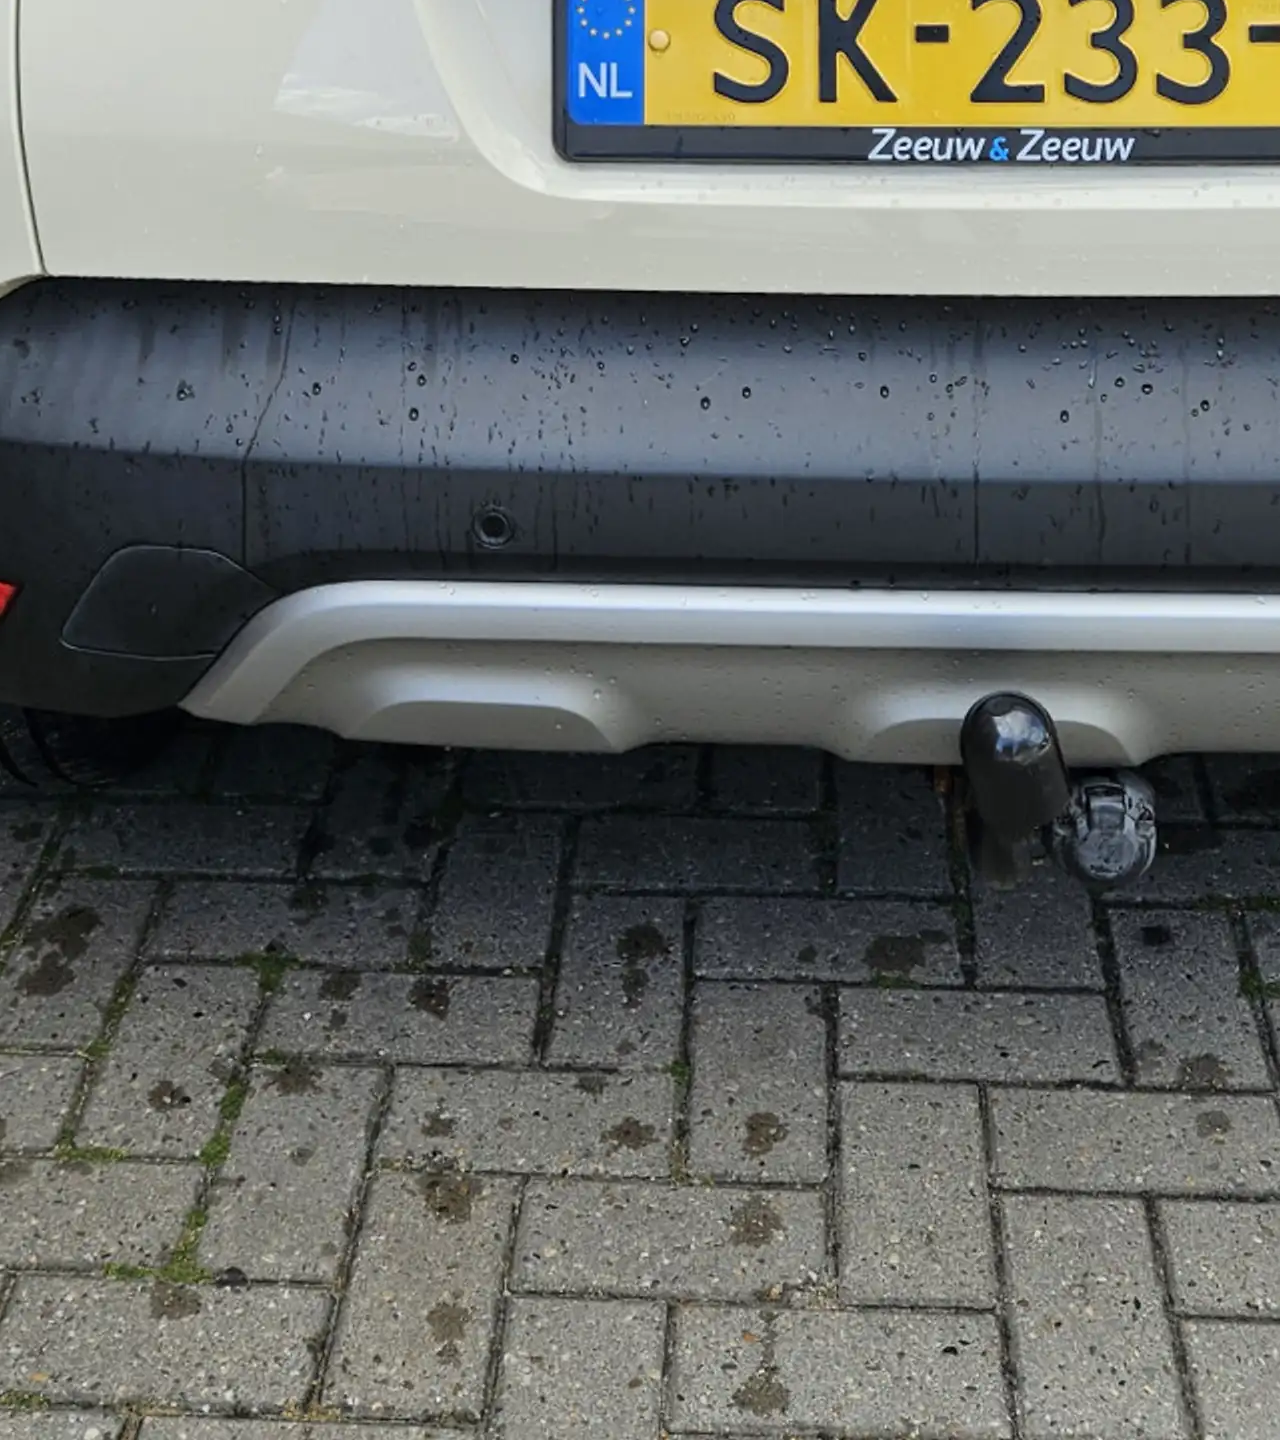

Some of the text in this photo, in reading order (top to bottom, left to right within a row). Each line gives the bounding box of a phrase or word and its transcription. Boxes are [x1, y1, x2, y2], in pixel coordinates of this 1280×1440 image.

[579, 62, 633, 98] NL
[868, 128, 1136, 161] Zeeuw & Zeeuw
